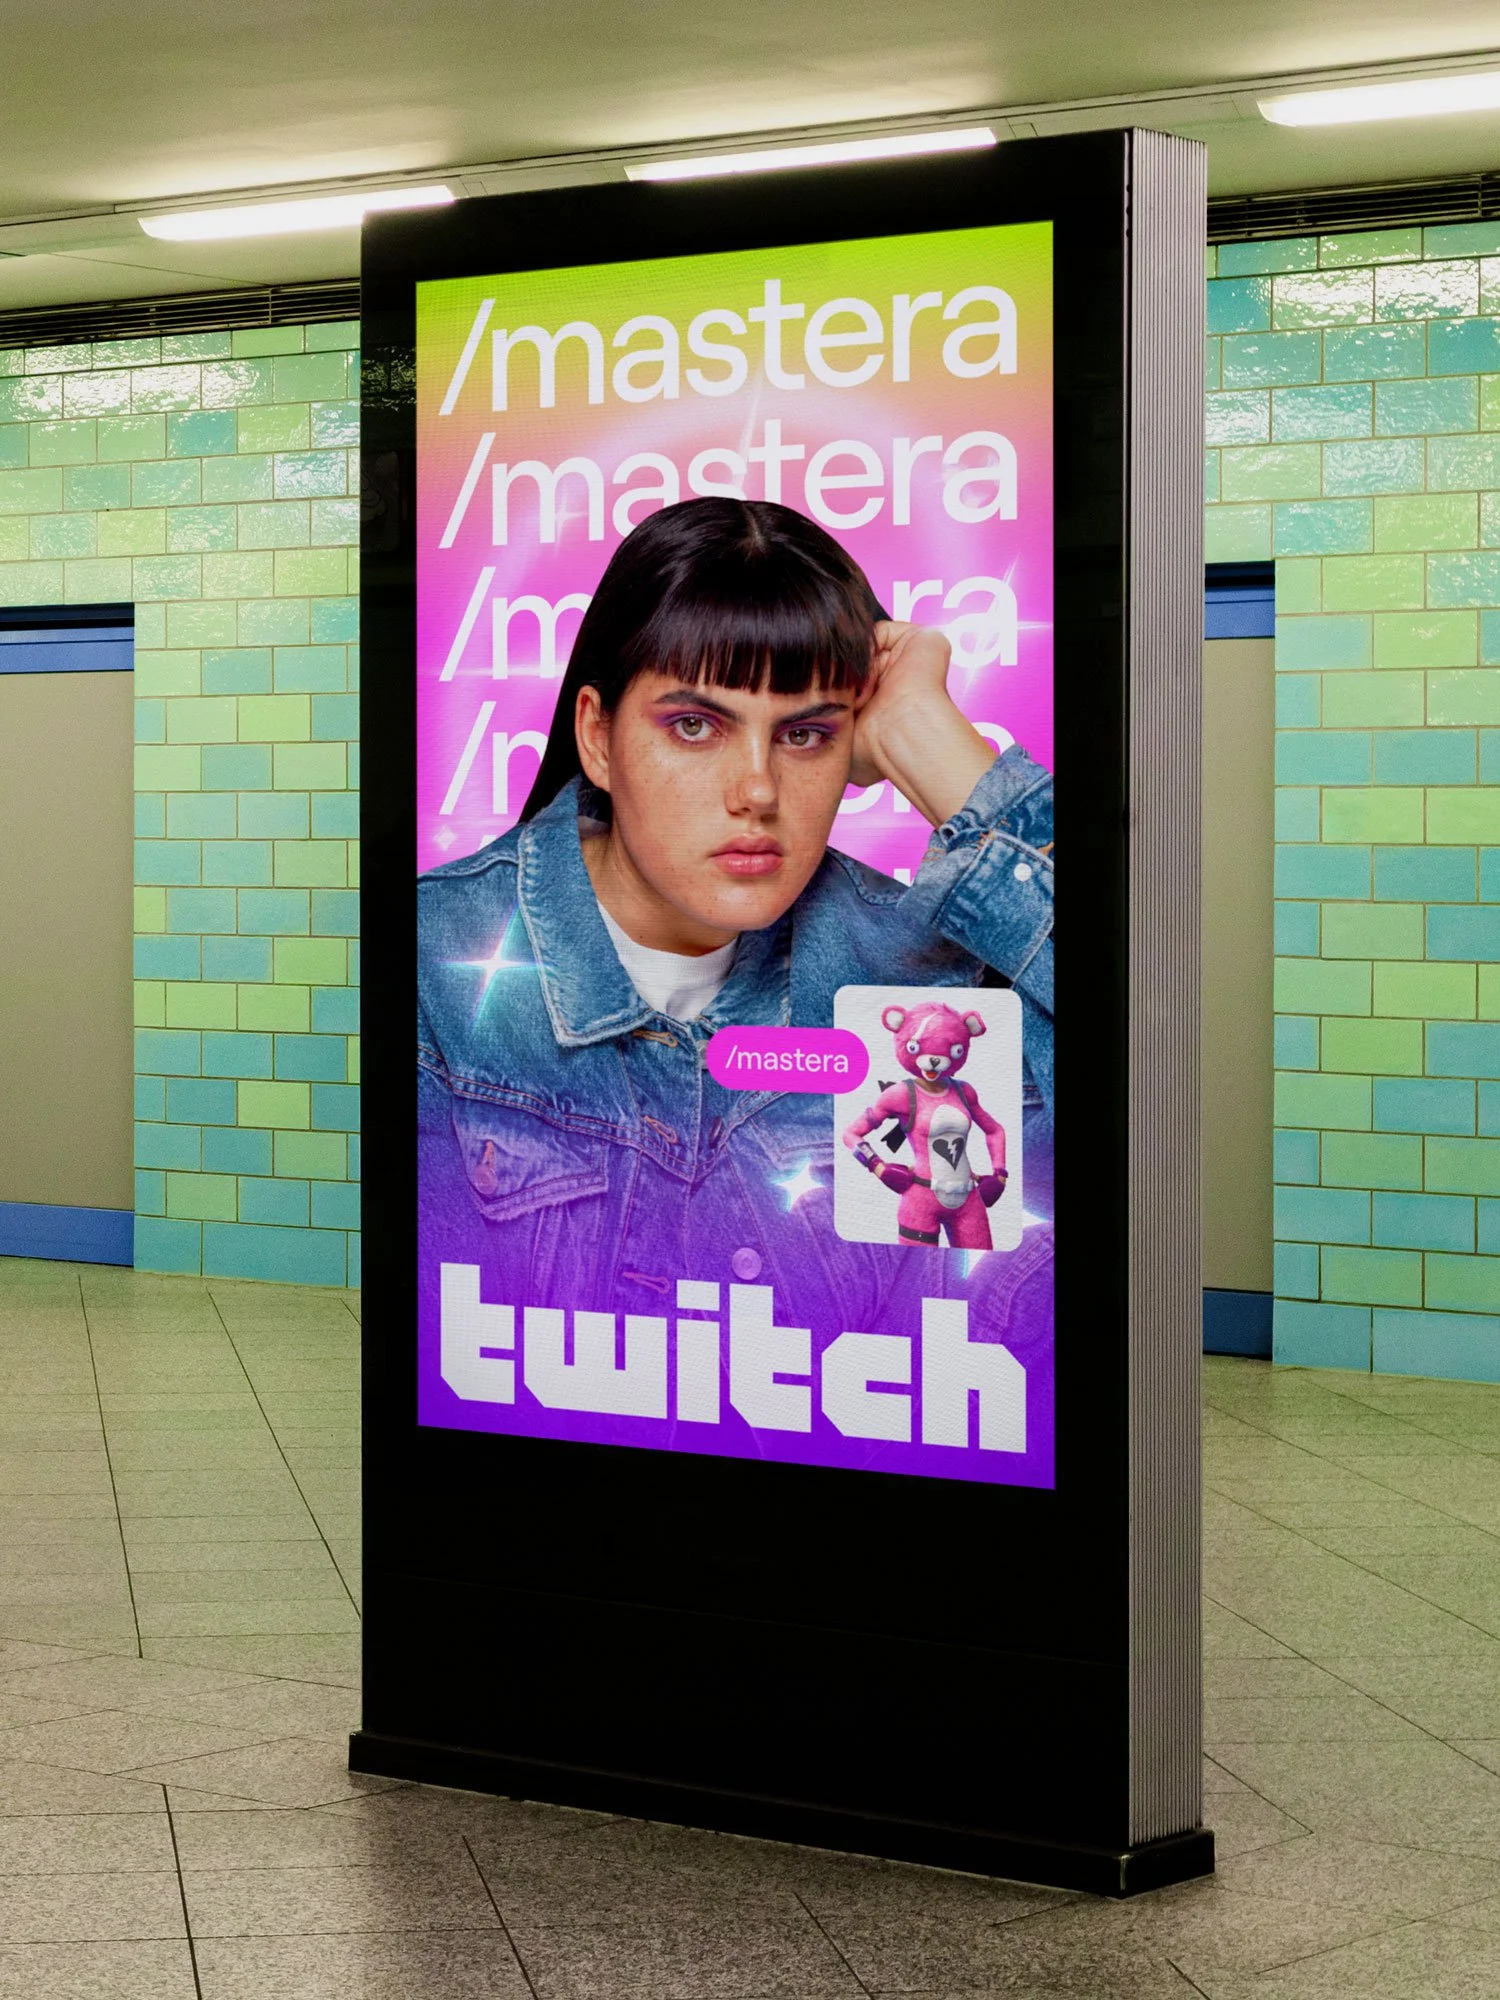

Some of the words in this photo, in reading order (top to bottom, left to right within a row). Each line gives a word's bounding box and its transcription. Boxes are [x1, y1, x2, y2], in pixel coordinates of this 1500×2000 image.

[438, 279, 1018, 416] /mastera
[725, 1044, 849, 1073] /mastera
[440, 1262, 1027, 1454] twitch
